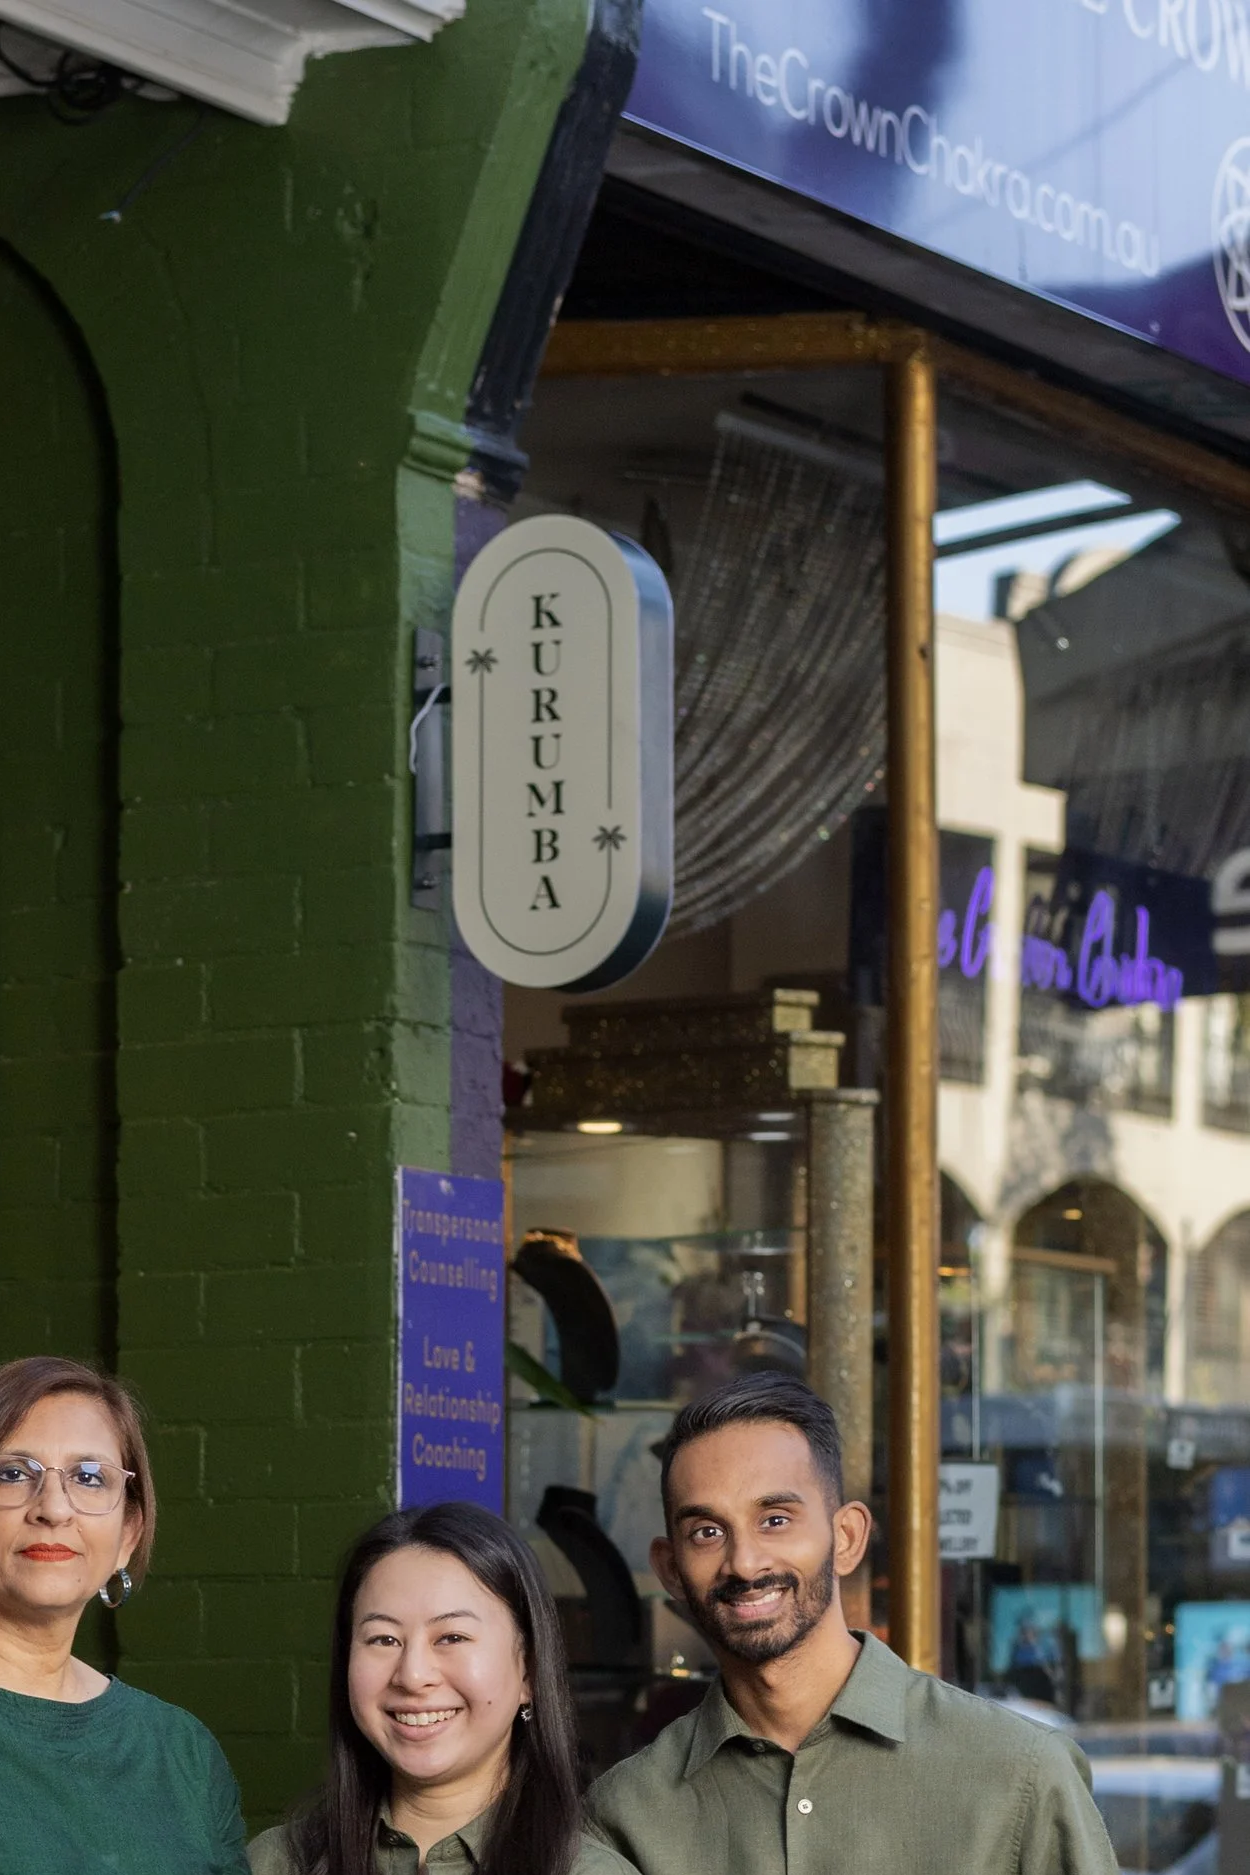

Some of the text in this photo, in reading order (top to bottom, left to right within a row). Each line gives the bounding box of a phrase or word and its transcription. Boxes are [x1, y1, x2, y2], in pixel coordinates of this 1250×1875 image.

[526, 592, 566, 911] KURUMBA
[403, 1199, 504, 1246] Transpersonal
[408, 1249, 498, 1303] Counselling
[423, 1336, 475, 1373] Love &
[404, 1382, 501, 1434] Relationship
[412, 1432, 488, 1483] Coaching
